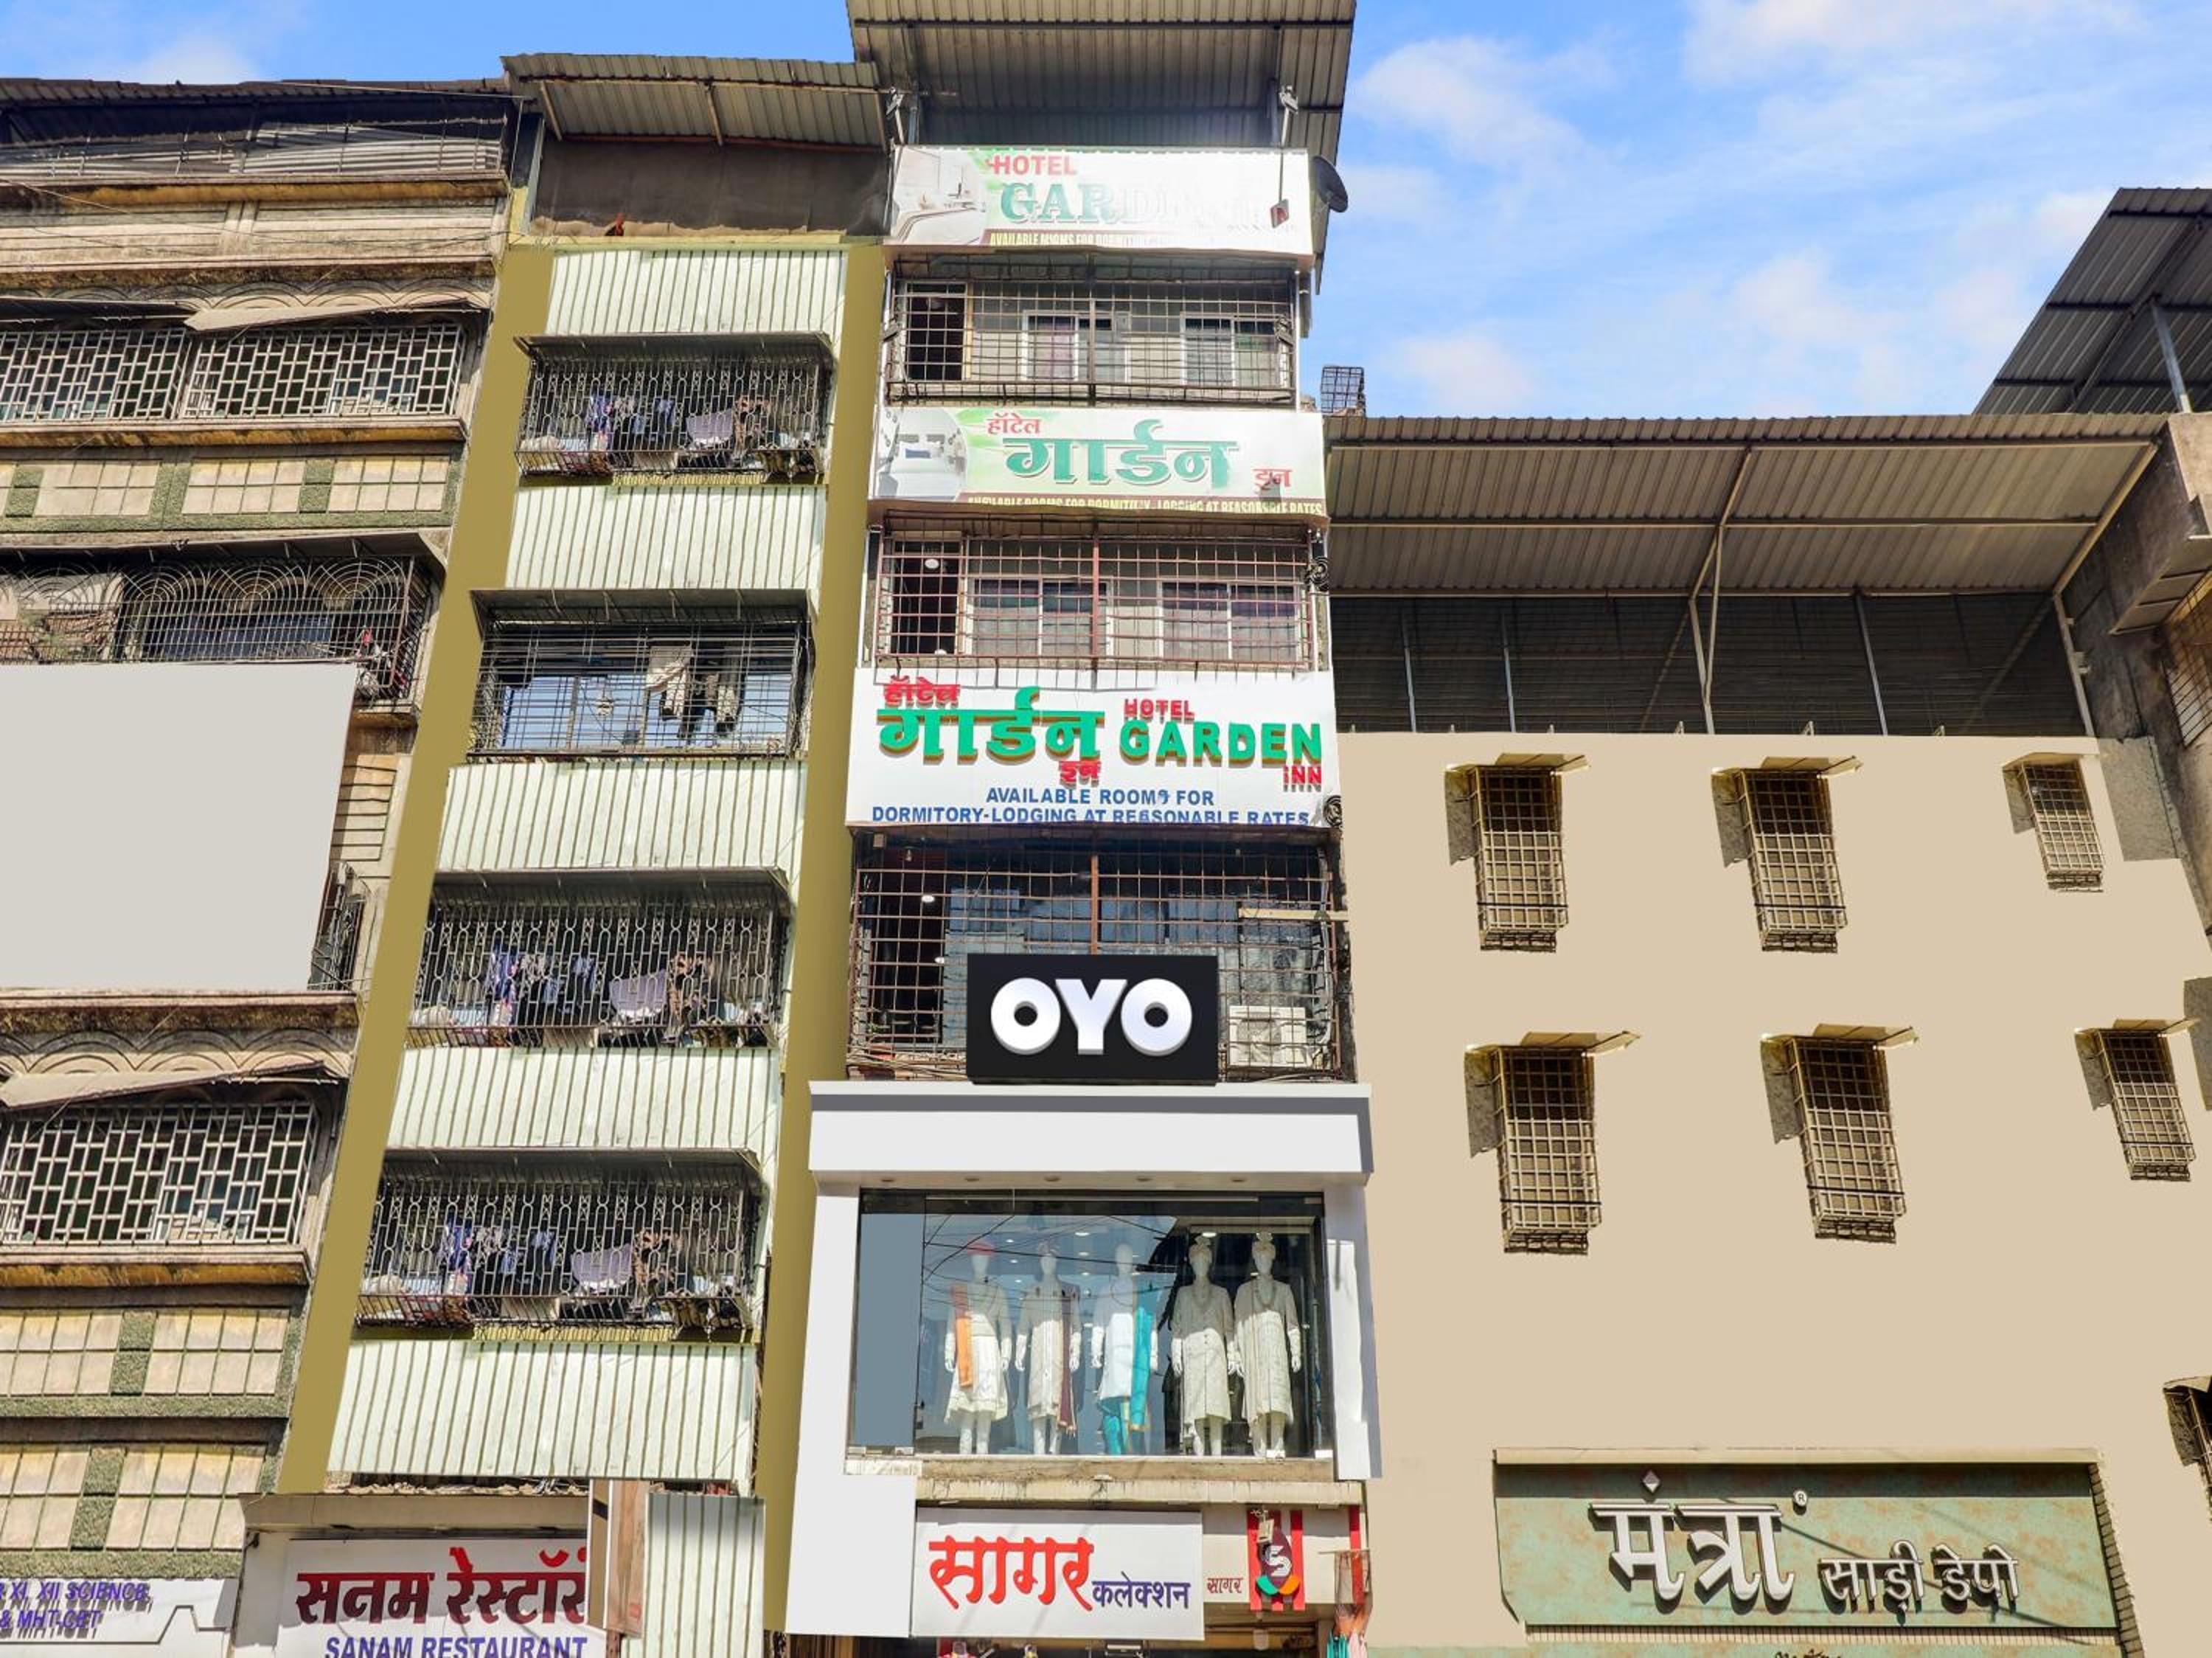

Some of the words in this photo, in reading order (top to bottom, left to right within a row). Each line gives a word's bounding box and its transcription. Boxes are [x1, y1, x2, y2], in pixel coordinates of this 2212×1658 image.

[992, 155, 1077, 176] HOTEL
[987, 412, 1041, 434] हॉटेल
[1003, 418, 1239, 489] गार्डन
[884, 675, 961, 707] हॉटेल
[877, 686, 1105, 764] गार्डन
[1124, 699, 1194, 720] HOTEL
[1120, 719, 1322, 765] GARDEN
[1282, 765, 1322, 785] INN
[986, 787, 1091, 804] AVAILABLE
[1177, 791, 1214, 805] FOR
[1085, 809, 1107, 822] AT
[1248, 811, 1310, 825] RATES
[990, 977, 1193, 1057] OYO
[1590, 1470, 1795, 1601] मंत्रा
[928, 1535, 1095, 1612] सागर
[1091, 1570, 1192, 1609] कलेक्शन
[1206, 1577, 1244, 1594] सागर
[1819, 1540, 1924, 1613] साड़ी
[1933, 1543, 2019, 1601] डेपो
[296, 1572, 435, 1624] सनम
[324, 1637, 413, 1658] SANAM
[422, 1637, 588, 1658] RESTAURANT
